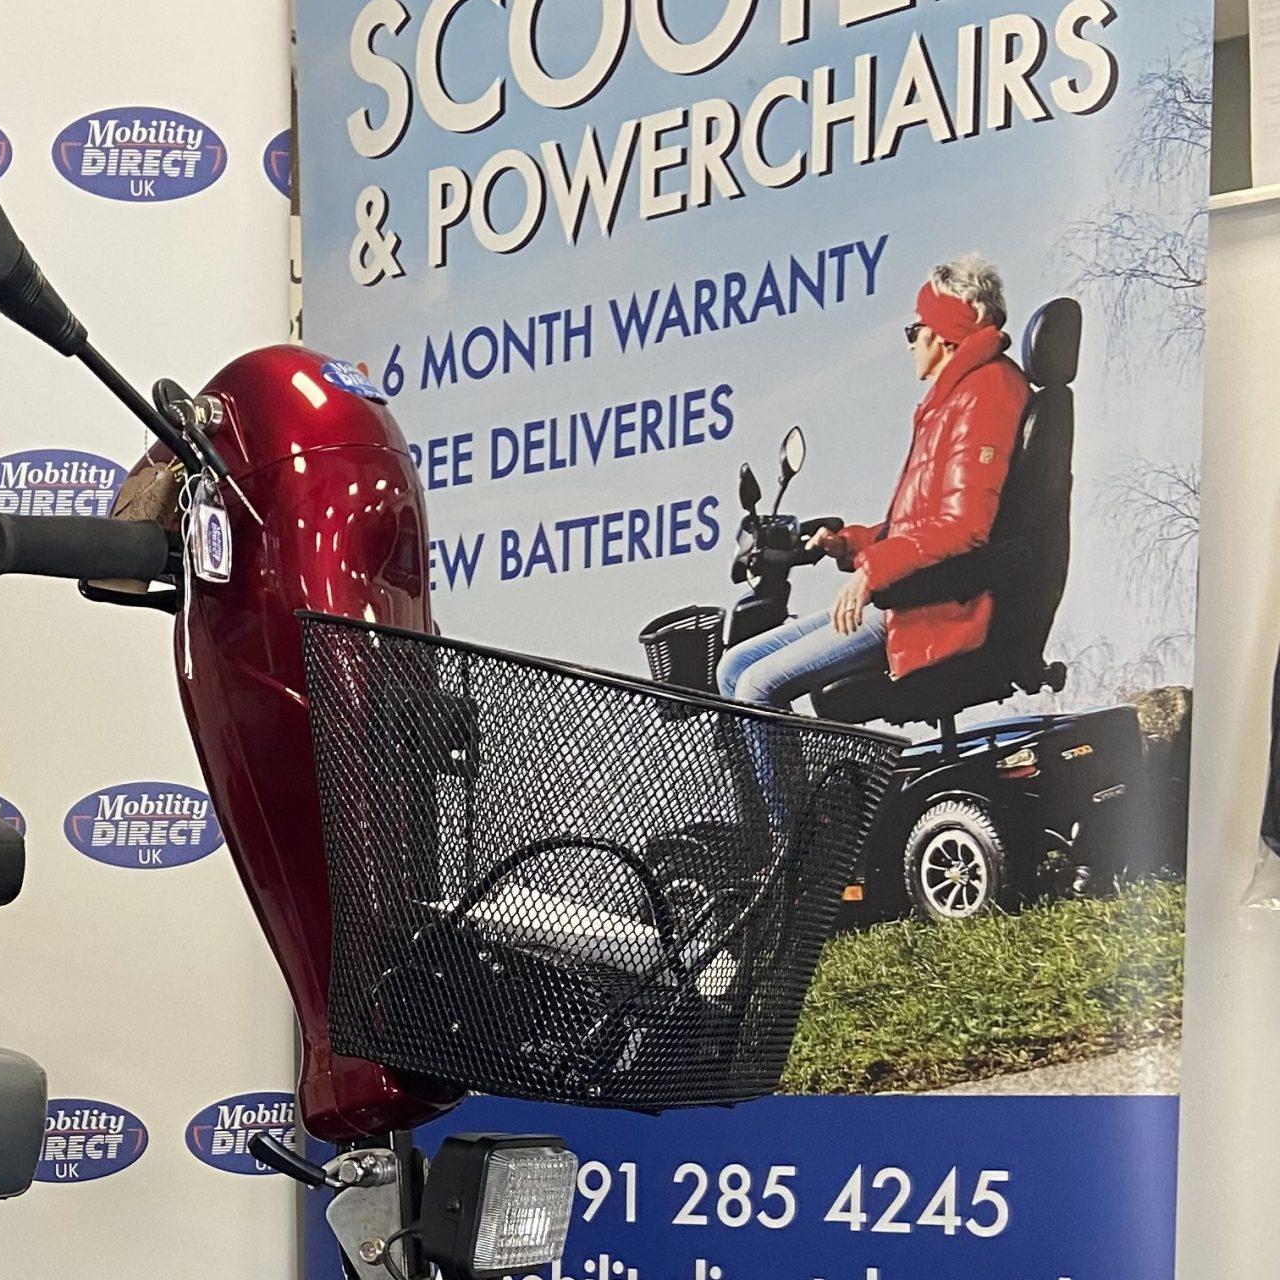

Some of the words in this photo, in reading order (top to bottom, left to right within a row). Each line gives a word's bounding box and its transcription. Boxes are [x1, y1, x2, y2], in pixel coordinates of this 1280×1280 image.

[347, 0, 917, 158] SCO
[84, 120, 203, 150] Mobility
[349, 185, 406, 286] &
[428, 0, 1119, 268] POWERCHAIRS
[82, 149, 201, 177] DIRECT
[131, 180, 155, 196] UK
[383, 344, 404, 397] 6
[421, 303, 593, 392] MONTH
[609, 233, 889, 352] WARRANTY
[492, 383, 734, 479] DELIVERIES
[501, 495, 721, 582] BATTERIES
[94, 794, 208, 820] Mobility
[92, 820, 206, 846] DIRECT
[139, 849, 162, 864] UK
[45, 1134, 124, 1161] RECT
[55, 1163, 79, 1178] UK
[577, 1161, 637, 1223] 91
[672, 1163, 796, 1229] 285
[824, 1165, 1011, 1238] 4245
